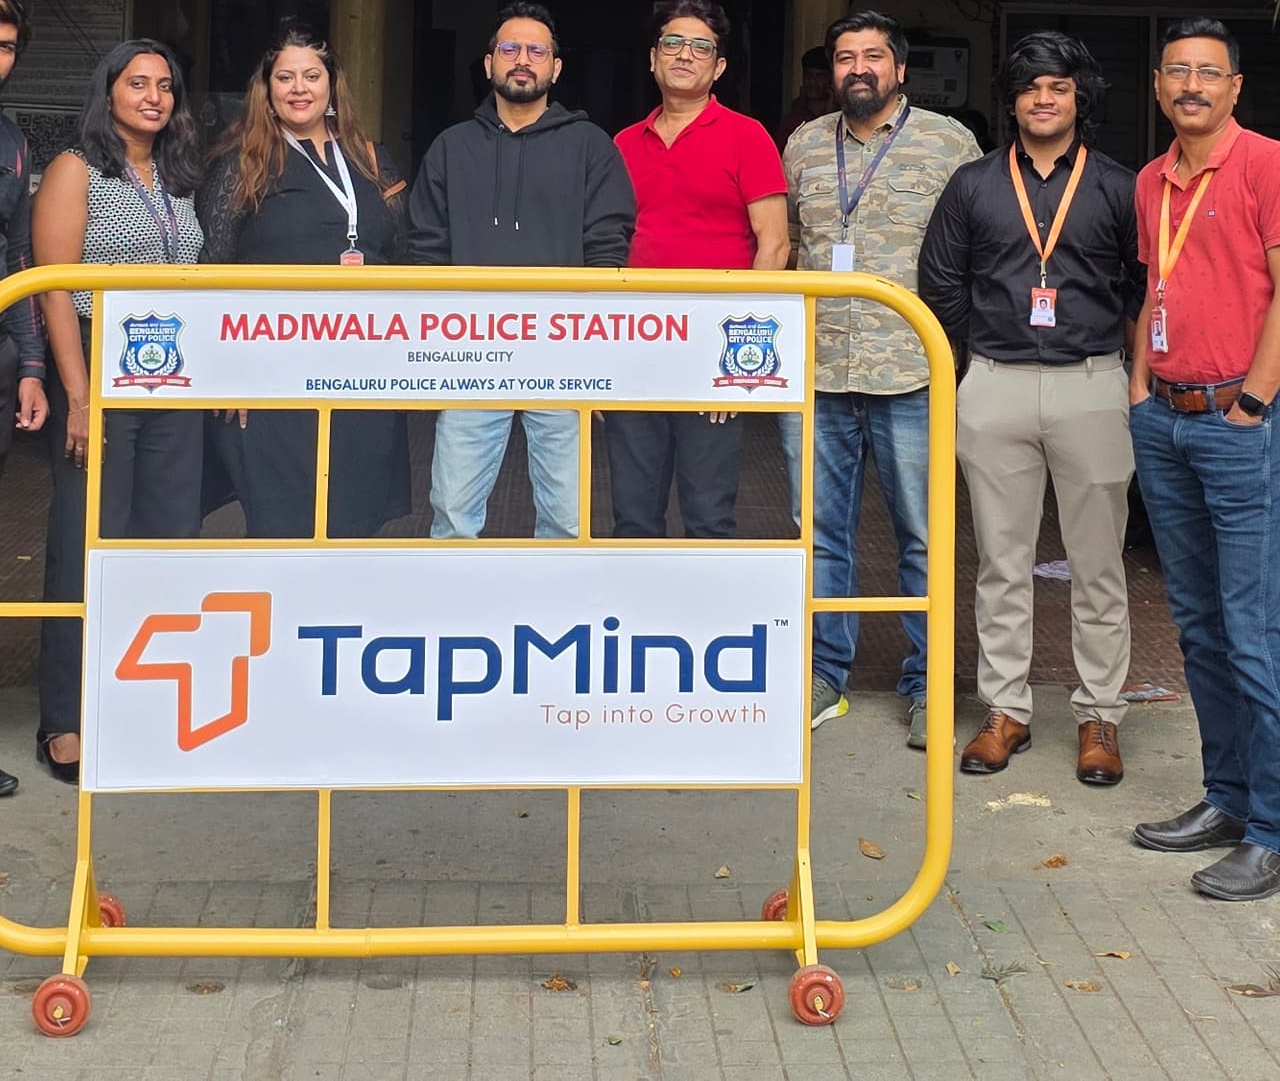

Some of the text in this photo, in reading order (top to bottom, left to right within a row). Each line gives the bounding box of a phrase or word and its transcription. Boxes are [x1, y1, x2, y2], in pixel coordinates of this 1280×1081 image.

[220, 313, 689, 343] MADIWALA POLICE STATION
[407, 351, 513, 363] BENGALURU CITY
[305, 378, 612, 391] BENGALURU POLICE ALWAYS AT YOUR SERVICE
[298, 616, 767, 722] TapMind
[540, 702, 767, 731] Tap into Growth
